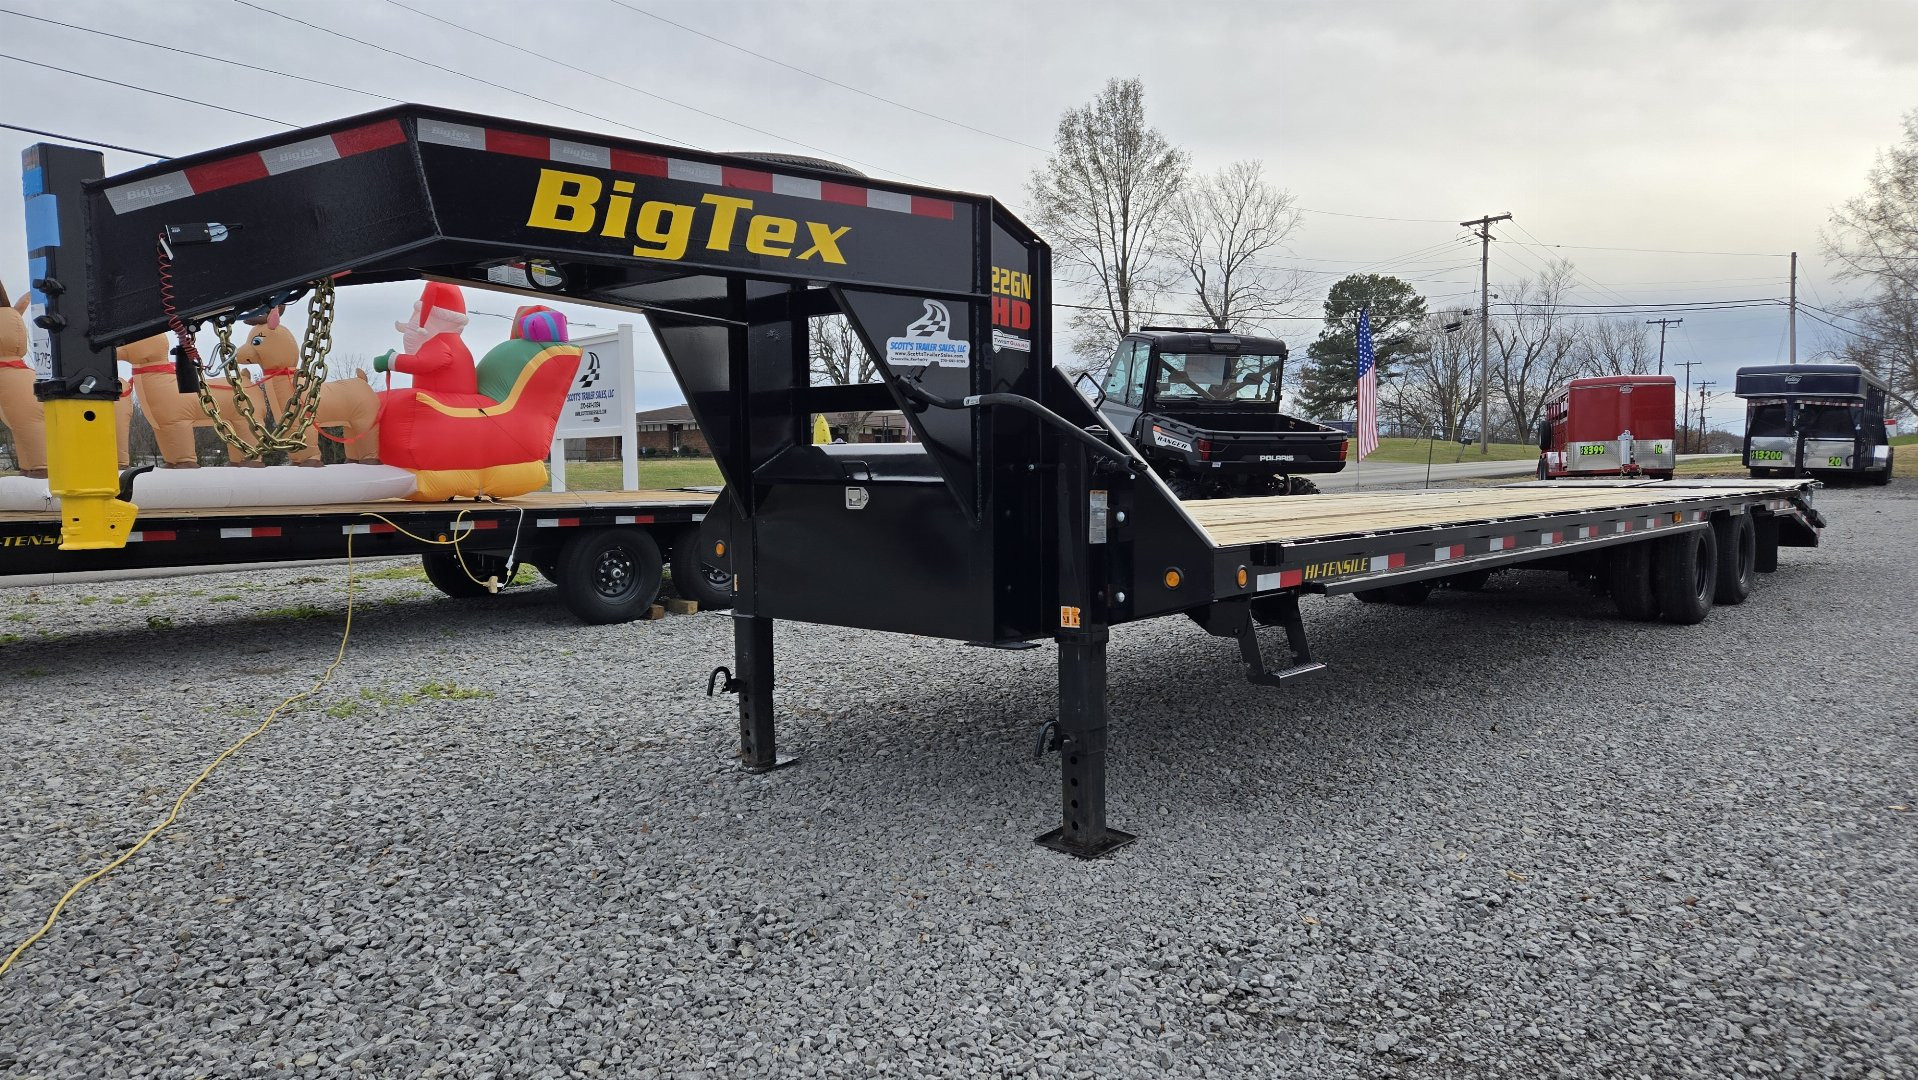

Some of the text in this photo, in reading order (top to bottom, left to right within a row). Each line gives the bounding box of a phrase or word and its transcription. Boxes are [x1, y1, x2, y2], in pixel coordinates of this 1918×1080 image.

[526, 168, 853, 265] BigTex
[992, 265, 1032, 300] 22GN
[992, 295, 1031, 331] HD
[890, 341, 967, 353] SCOTT'S TRAILER SALES, LLC
[1157, 435, 1188, 449] RANGER
[1580, 444, 1604, 455] $8399
[1655, 444, 1663, 454] 16
[1751, 450, 1782, 460] $13200
[1259, 454, 1294, 462] POLARIS
[1828, 456, 1842, 466] 20
[1304, 557, 1369, 580] HI-TENSILE
